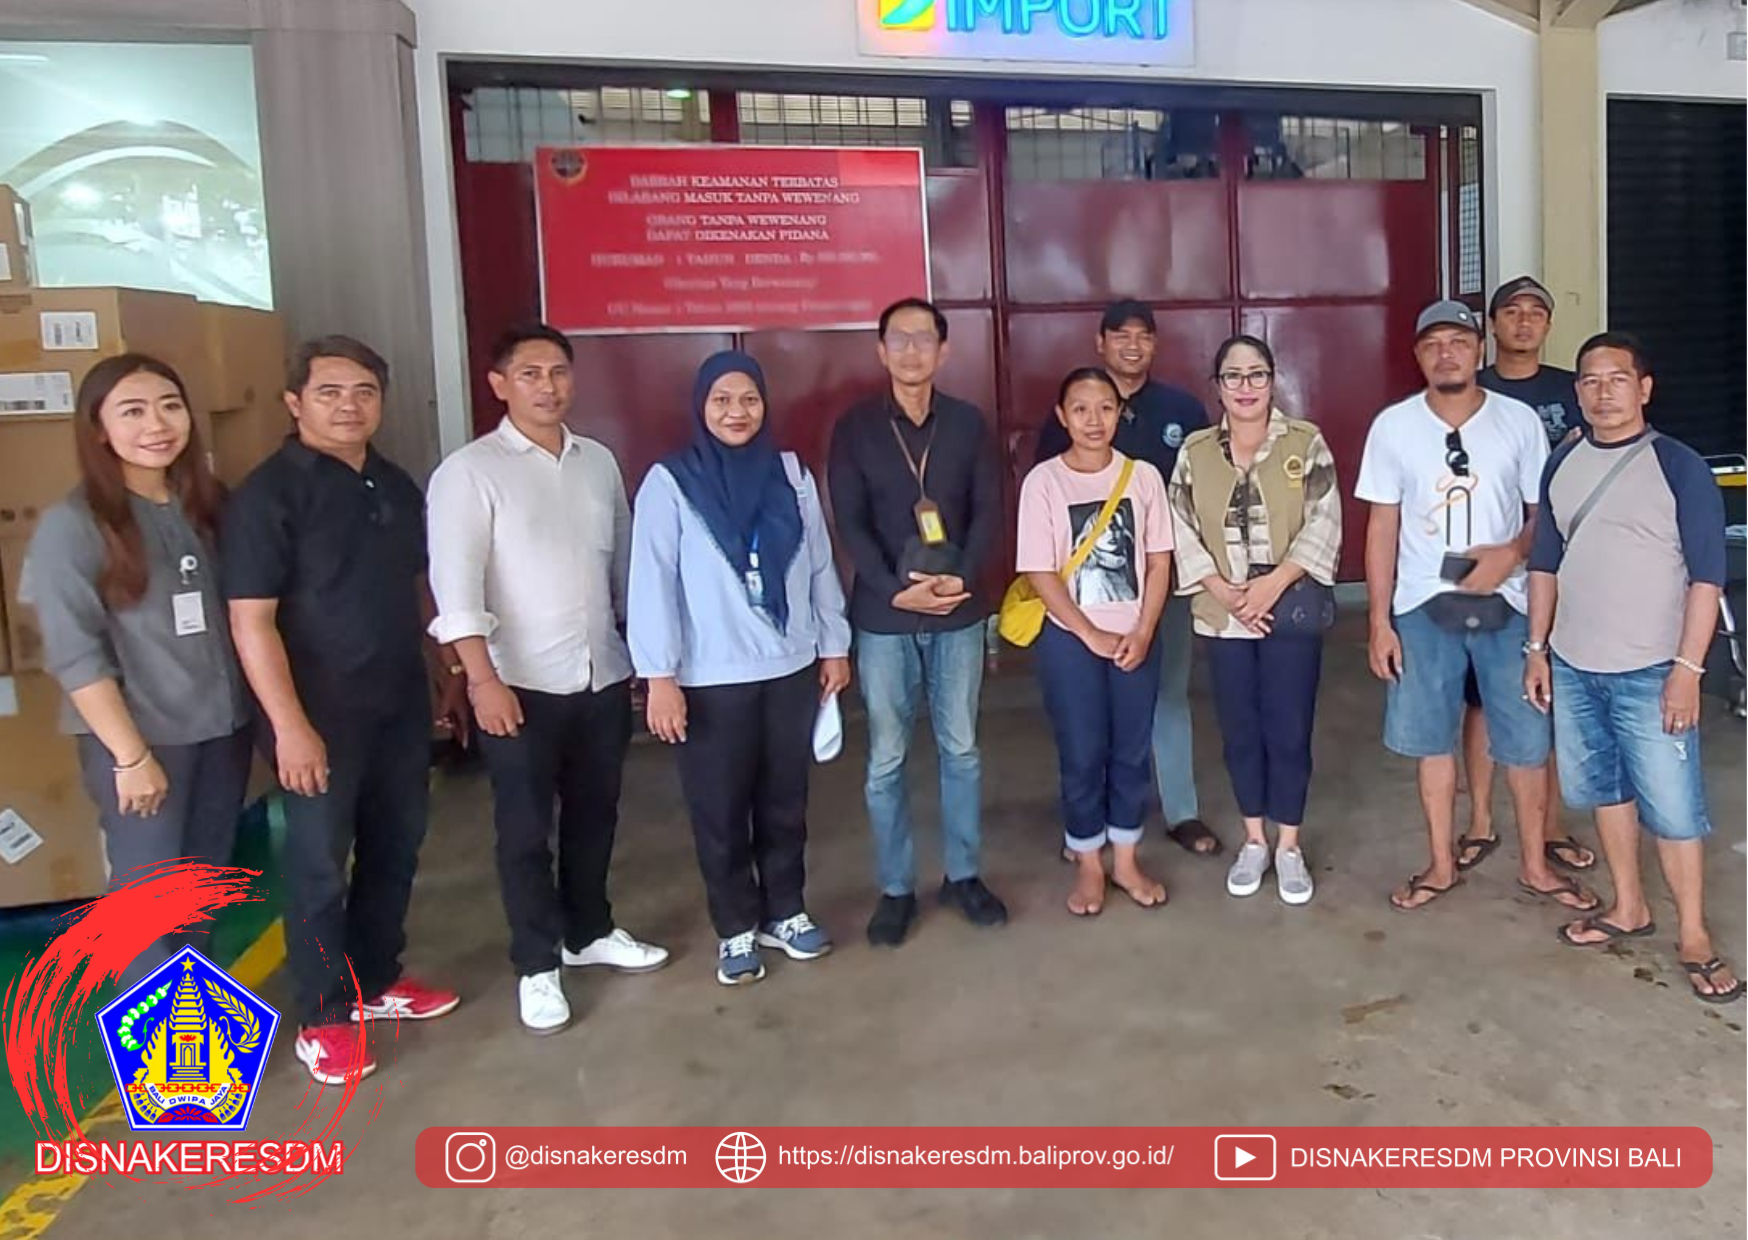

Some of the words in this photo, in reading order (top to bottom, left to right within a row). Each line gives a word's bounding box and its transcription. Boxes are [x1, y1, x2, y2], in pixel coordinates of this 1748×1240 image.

[946, 0, 1169, 39] IMPORT
[691, 176, 768, 188] KEAMANAN
[770, 177, 838, 188] TERBATAS
[684, 191, 733, 203] MASUK
[735, 191, 779, 203] TANPA
[781, 192, 860, 204] WEWENANG
[699, 215, 745, 226] TANPA
[747, 214, 827, 226] WEWENANG
[694, 229, 775, 241] DIKENAKAN
[778, 229, 829, 241] PIDANA
